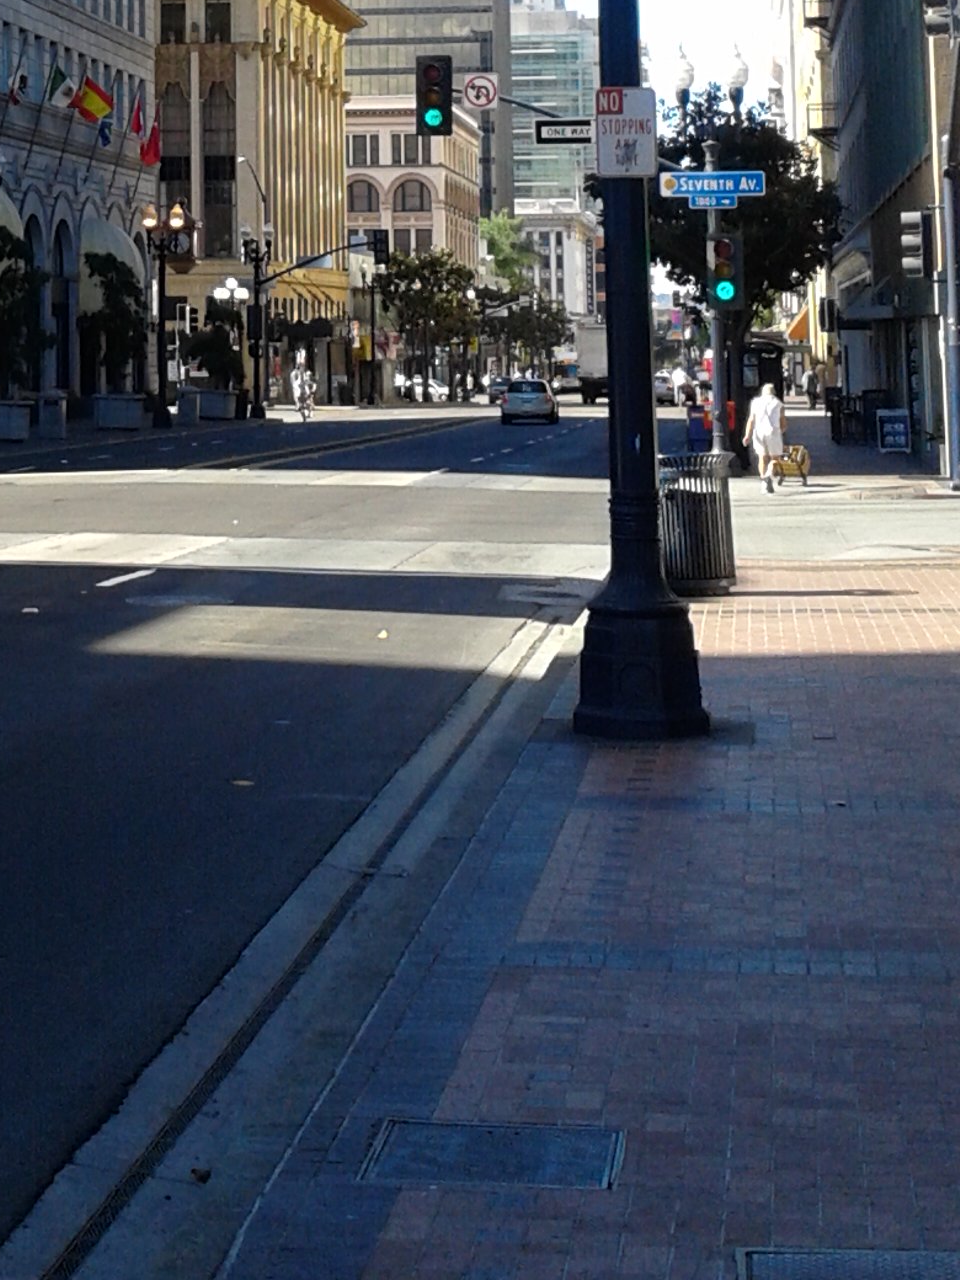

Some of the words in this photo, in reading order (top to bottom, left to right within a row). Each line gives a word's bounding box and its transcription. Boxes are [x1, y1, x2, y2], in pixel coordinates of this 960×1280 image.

[599, 92, 619, 112] NO
[546, 127, 567, 137] ONE
[570, 127, 591, 137] WAY
[601, 118, 652, 136] STOPPING
[680, 177, 734, 192] SEVENTH
[739, 176, 760, 191] AV.
